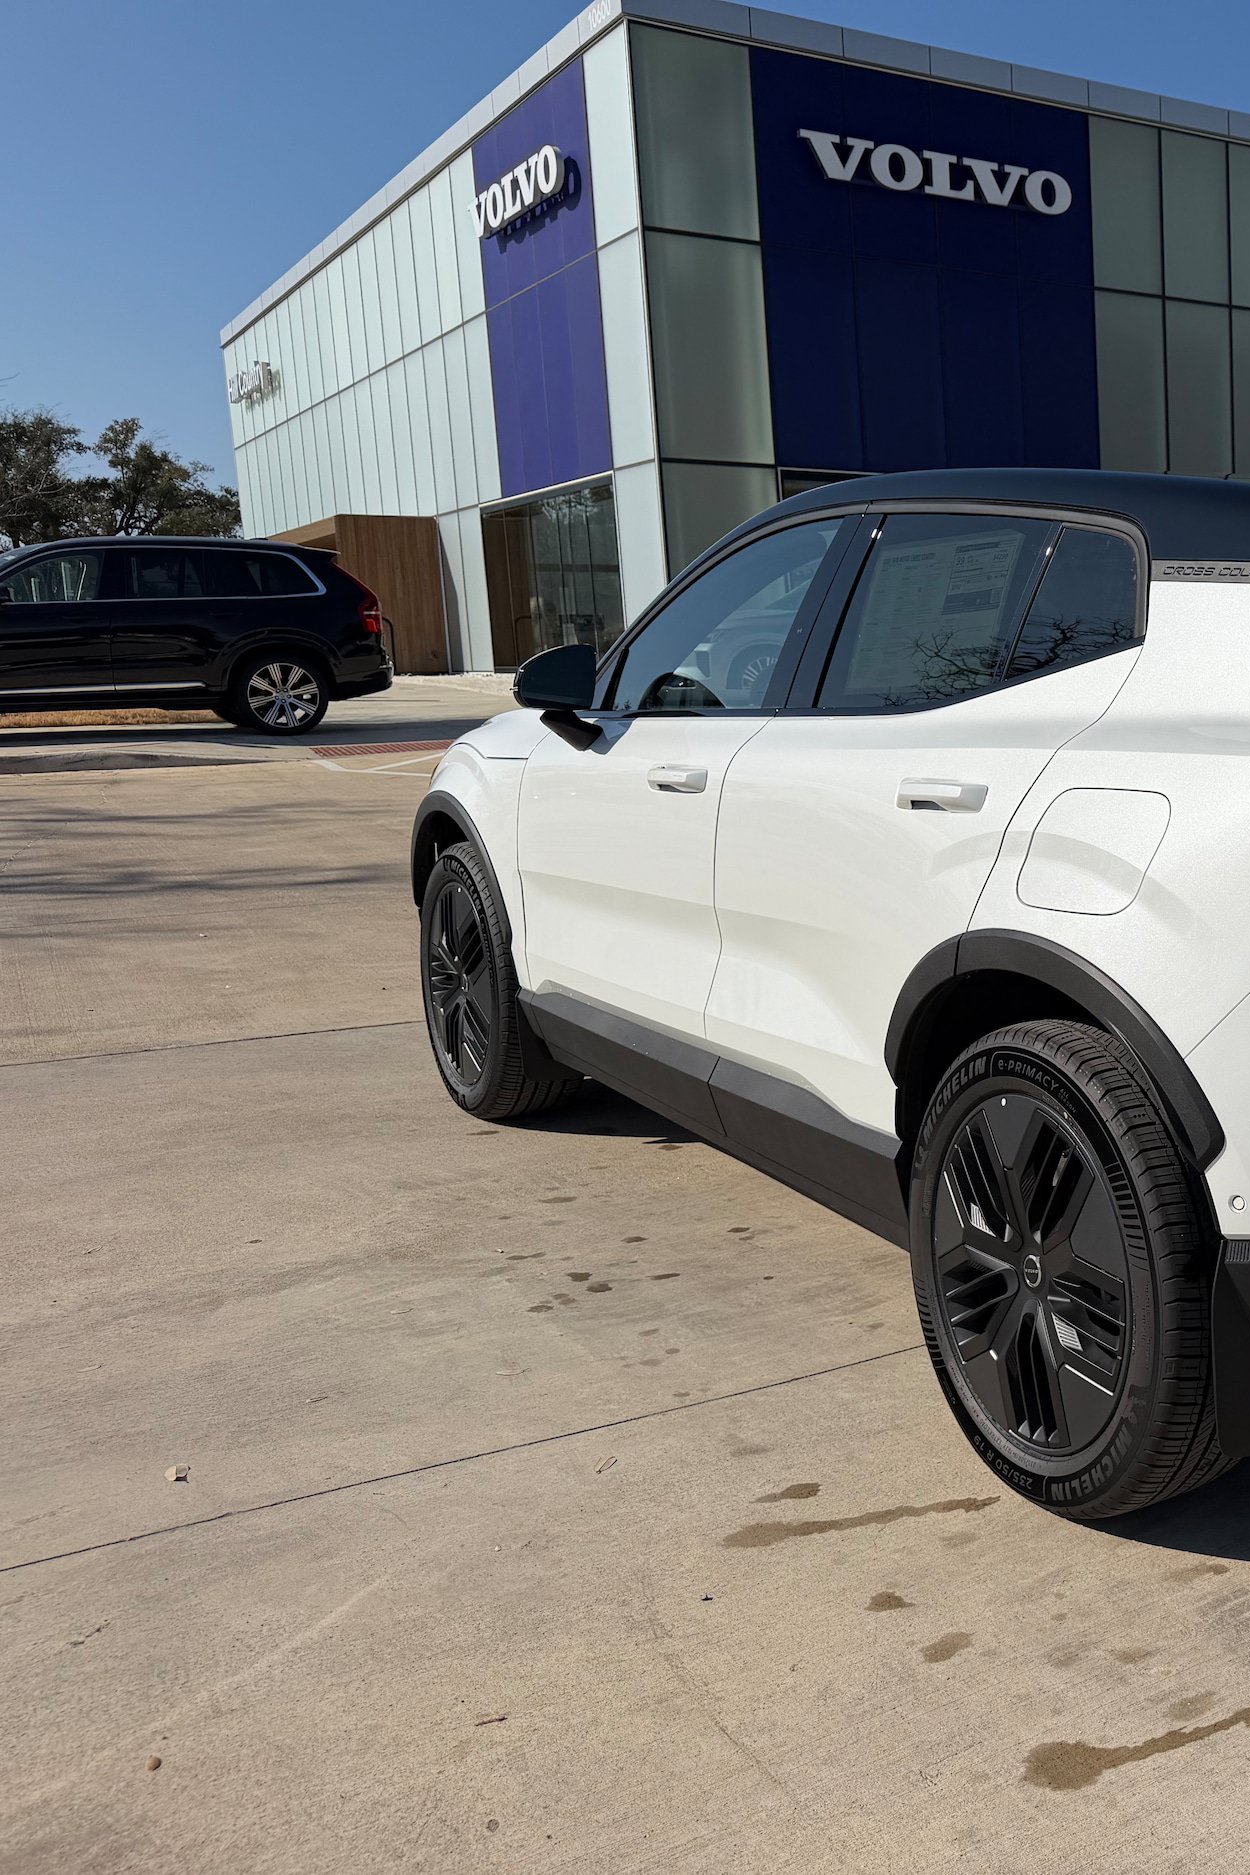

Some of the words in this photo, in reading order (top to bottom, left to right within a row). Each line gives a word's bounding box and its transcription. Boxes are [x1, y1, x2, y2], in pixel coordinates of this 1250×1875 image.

[467, 145, 559, 238] VOLVO
[799, 128, 1073, 215] VOLVO
[1163, 566, 1216, 576] CROSS
[922, 1055, 987, 1145] MICHELIN
[973, 1434, 985, 1451] 19
[986, 1449, 995, 1460] R
[1050, 1424, 1133, 1501] MICHELIN
[995, 1457, 1033, 1490] 235/50
